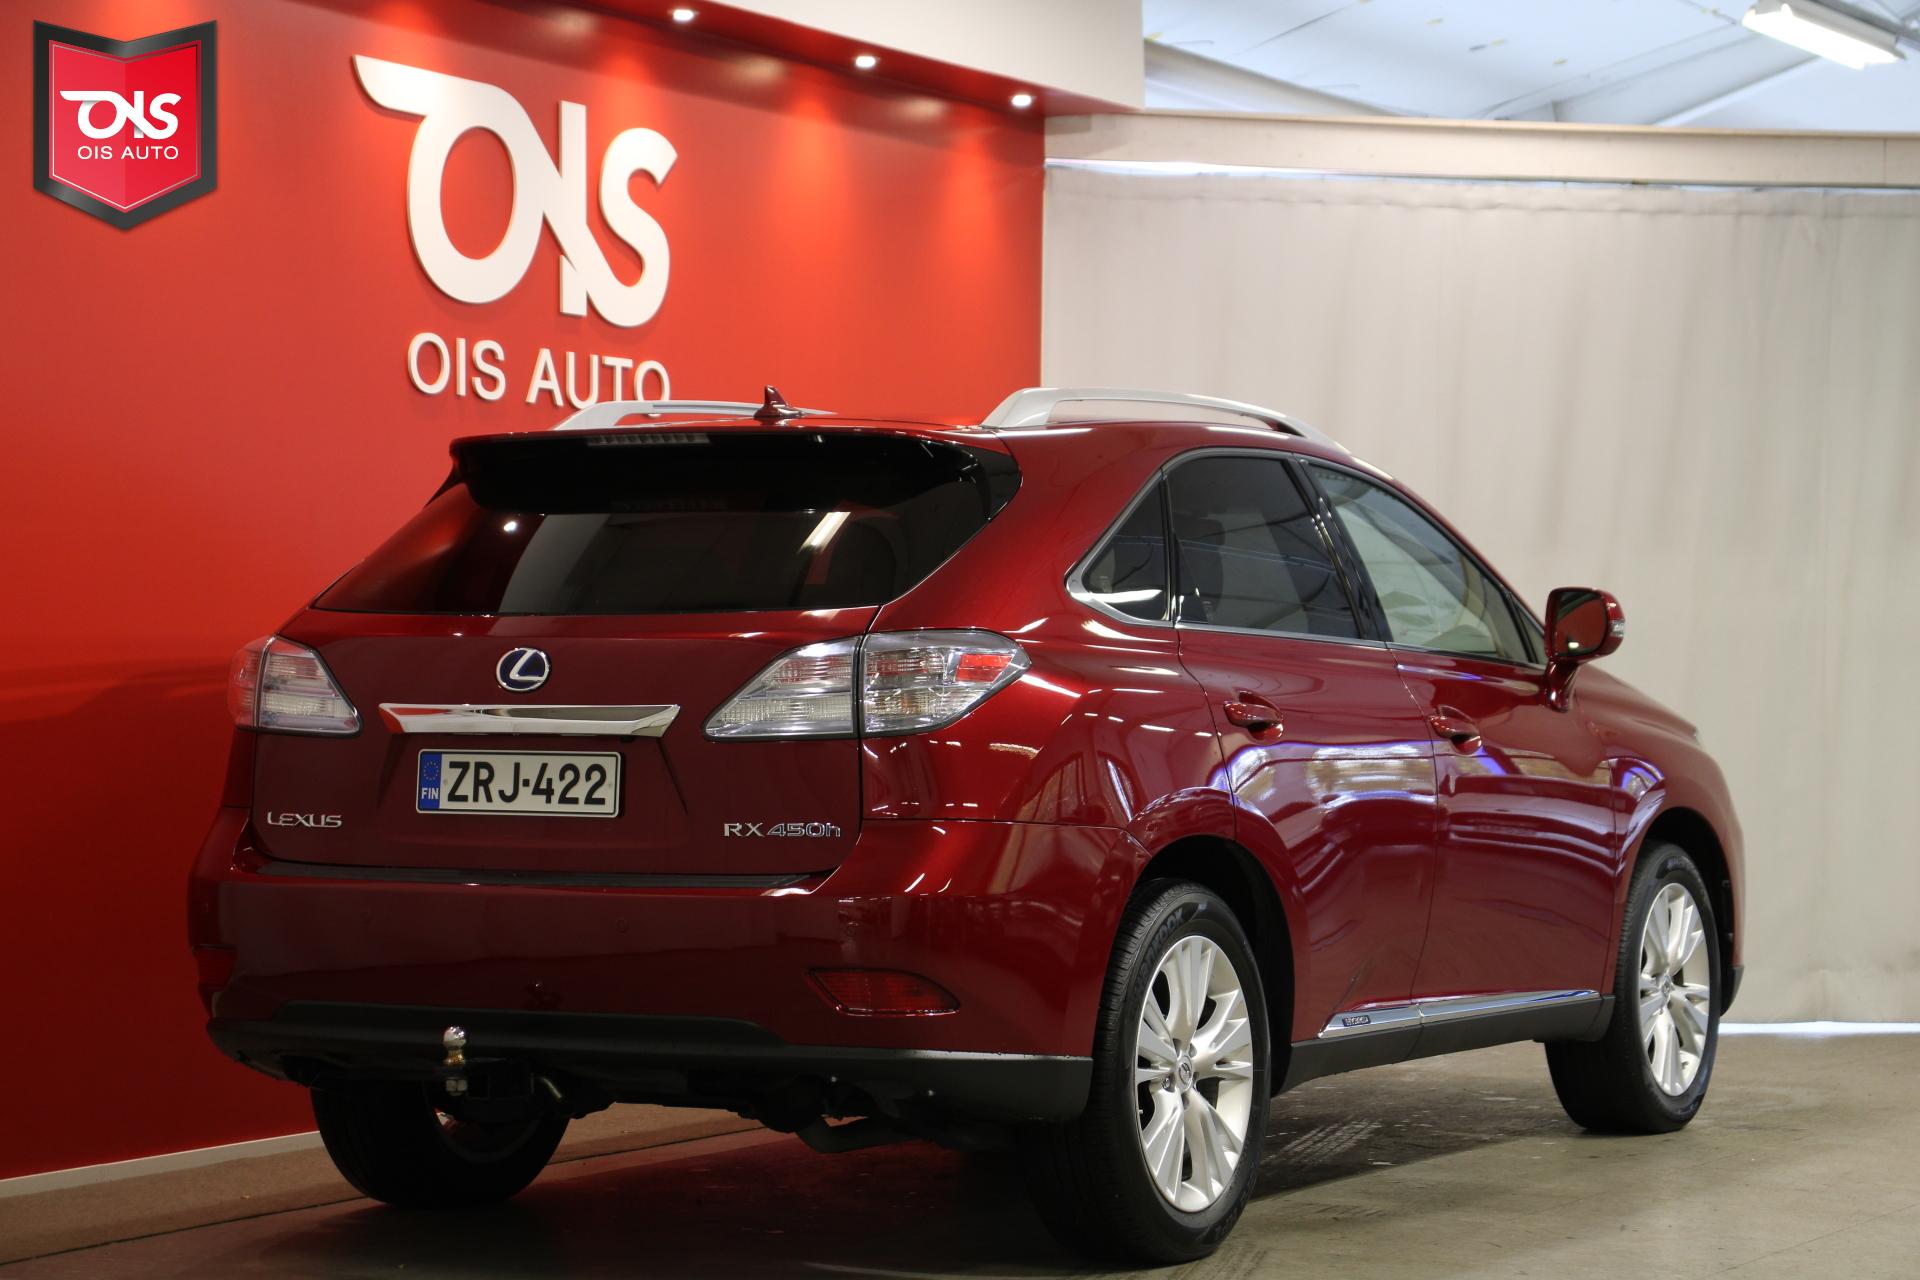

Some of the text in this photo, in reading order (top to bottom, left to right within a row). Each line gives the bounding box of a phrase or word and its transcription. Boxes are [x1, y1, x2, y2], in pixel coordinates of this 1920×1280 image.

[407, 332, 671, 417] OIS AUTO
[447, 761, 607, 806] ZRJ-422
[421, 787, 440, 800] FIN
[266, 811, 342, 829] LEXUS
[723, 822, 841, 838] RX 450h
